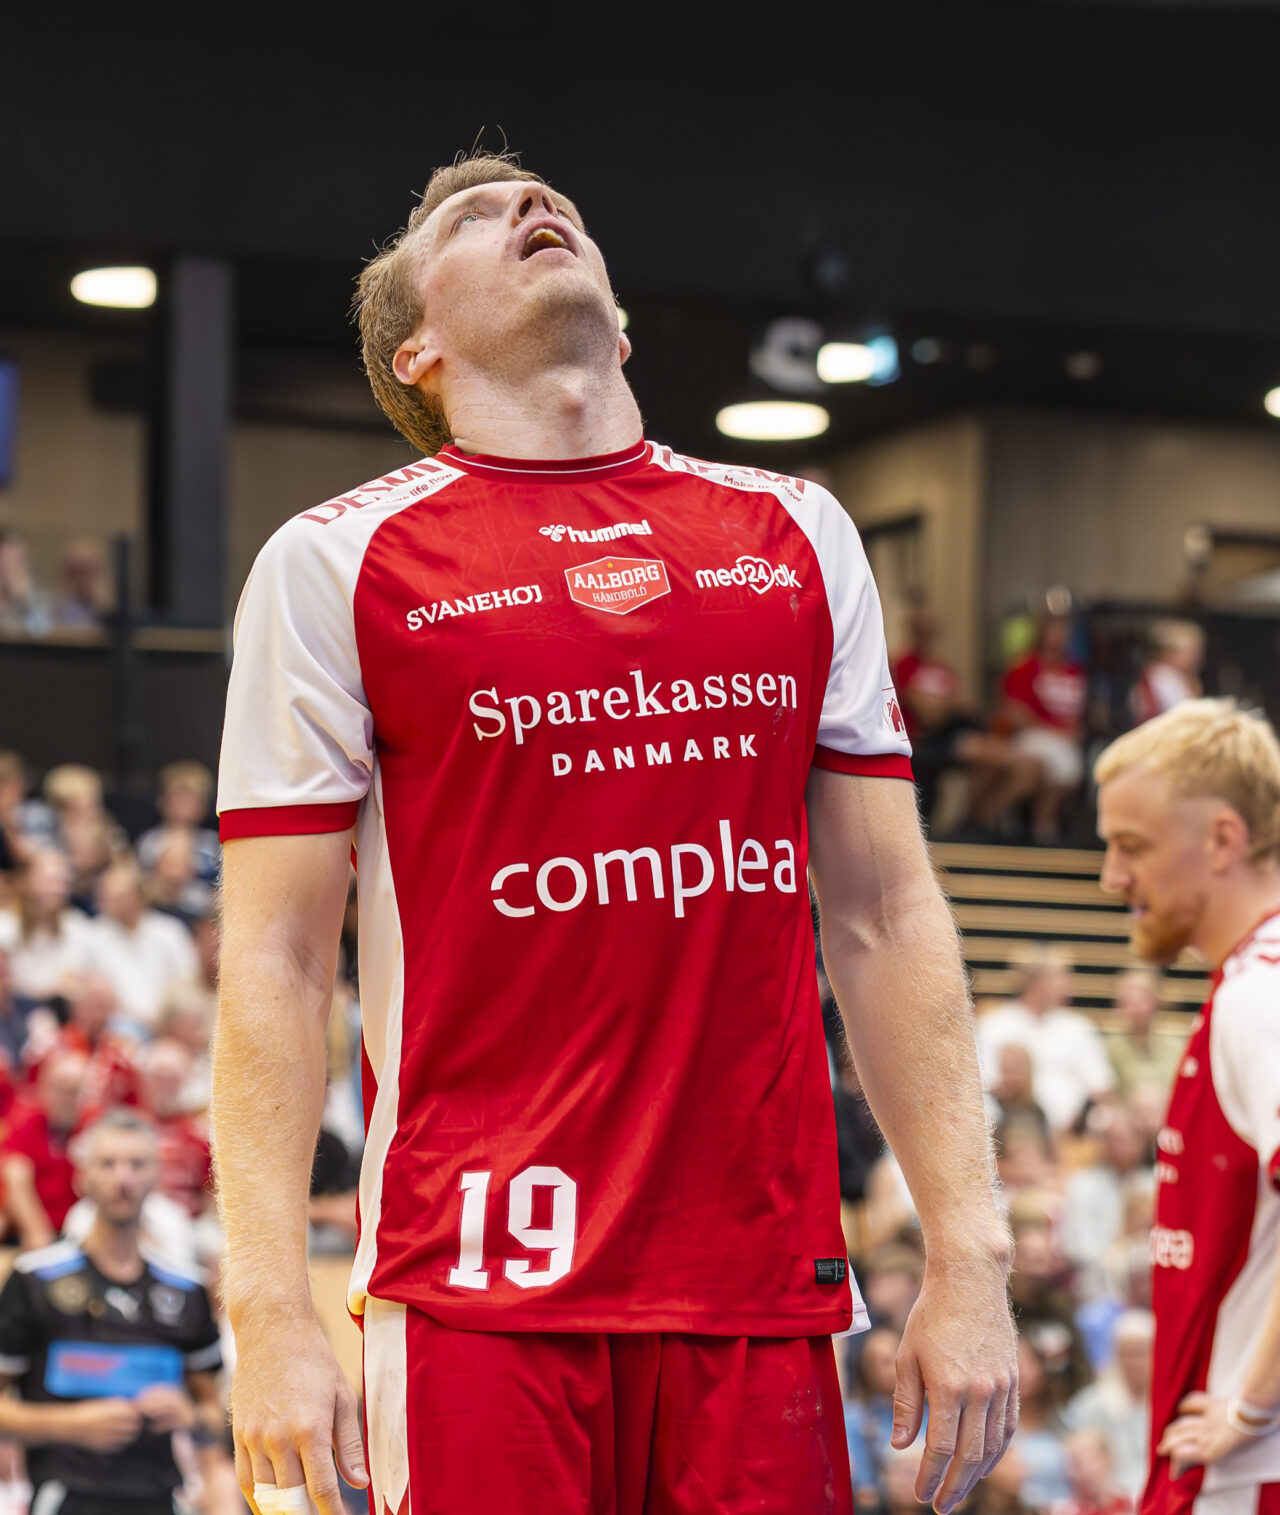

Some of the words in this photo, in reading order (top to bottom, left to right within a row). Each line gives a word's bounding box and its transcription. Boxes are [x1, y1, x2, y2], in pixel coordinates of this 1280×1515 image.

[298, 463, 444, 526] DESMI
[566, 519, 652, 543] hummel
[574, 564, 661, 590] AALBORG
[695, 557, 803, 592] med24.dk
[406, 585, 542, 631] SVANEHØJ
[469, 669, 798, 745] Sparekassen
[552, 734, 758, 777] DANMARK
[490, 819, 798, 918] complea
[447, 1165, 577, 1290] 19
